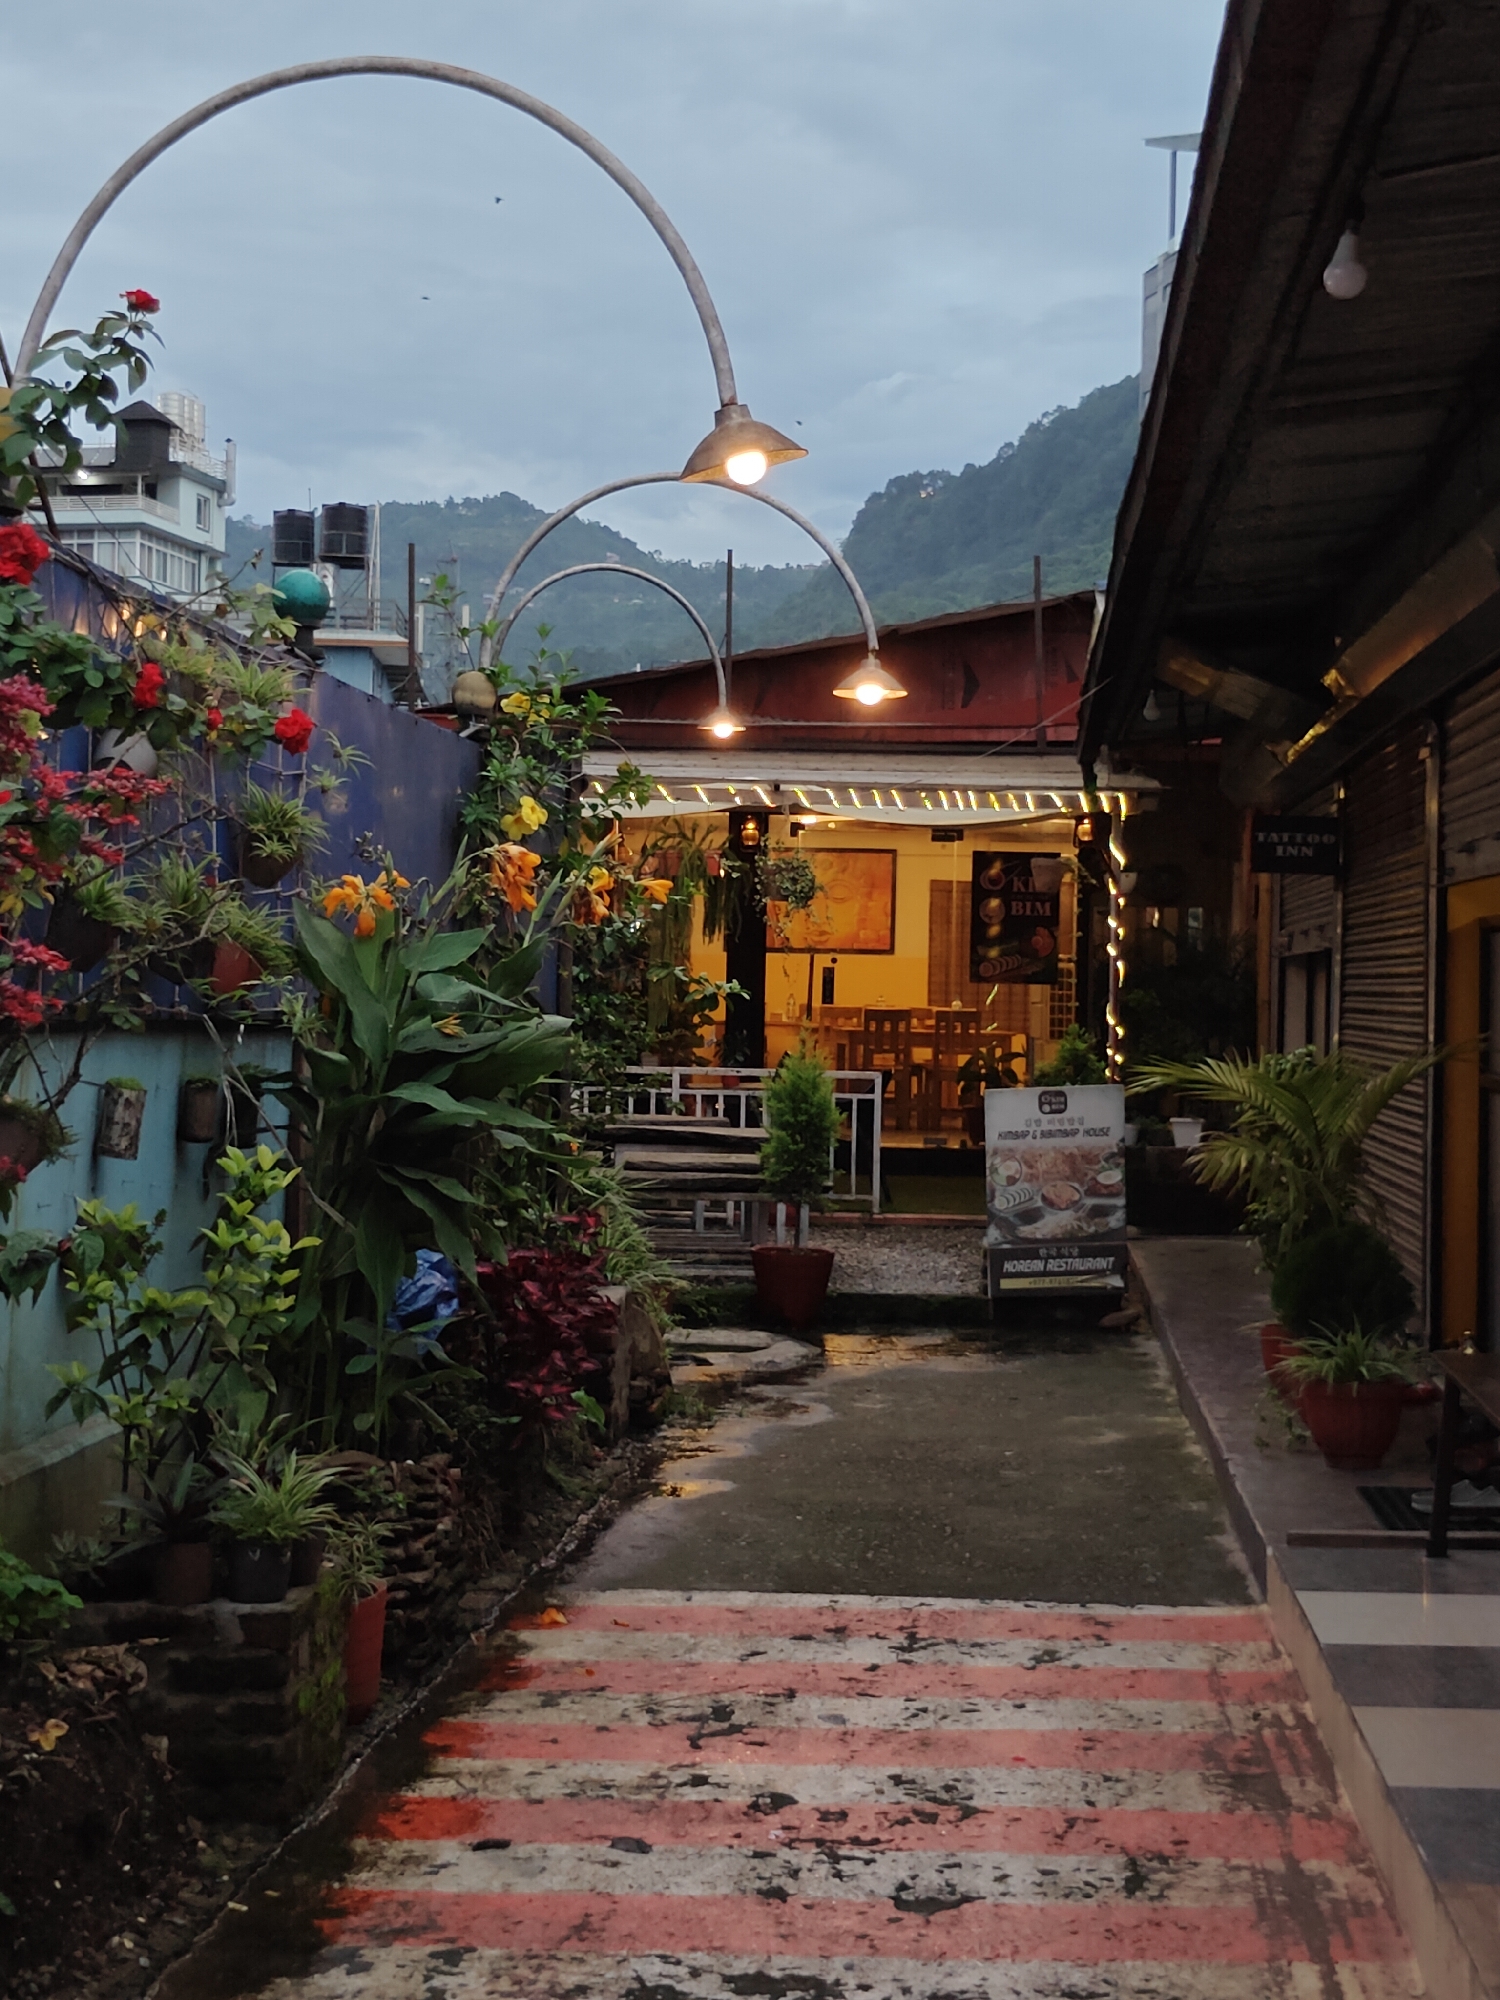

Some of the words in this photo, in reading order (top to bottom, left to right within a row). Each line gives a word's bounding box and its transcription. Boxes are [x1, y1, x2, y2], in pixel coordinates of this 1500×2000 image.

[1255, 832, 1336, 844] TATTOO
[1275, 845, 1313, 857] INN
[1011, 901, 1052, 916] BIM
[997, 1130, 1030, 1140] KIMBAP
[1031, 1129, 1038, 1139] &
[1039, 1128, 1080, 1139] BIBIMBAP
[1083, 1127, 1111, 1137] HOUSE
[1003, 1260, 1045, 1272] KOREAN
[1046, 1257, 1115, 1271] RESTAURANT
